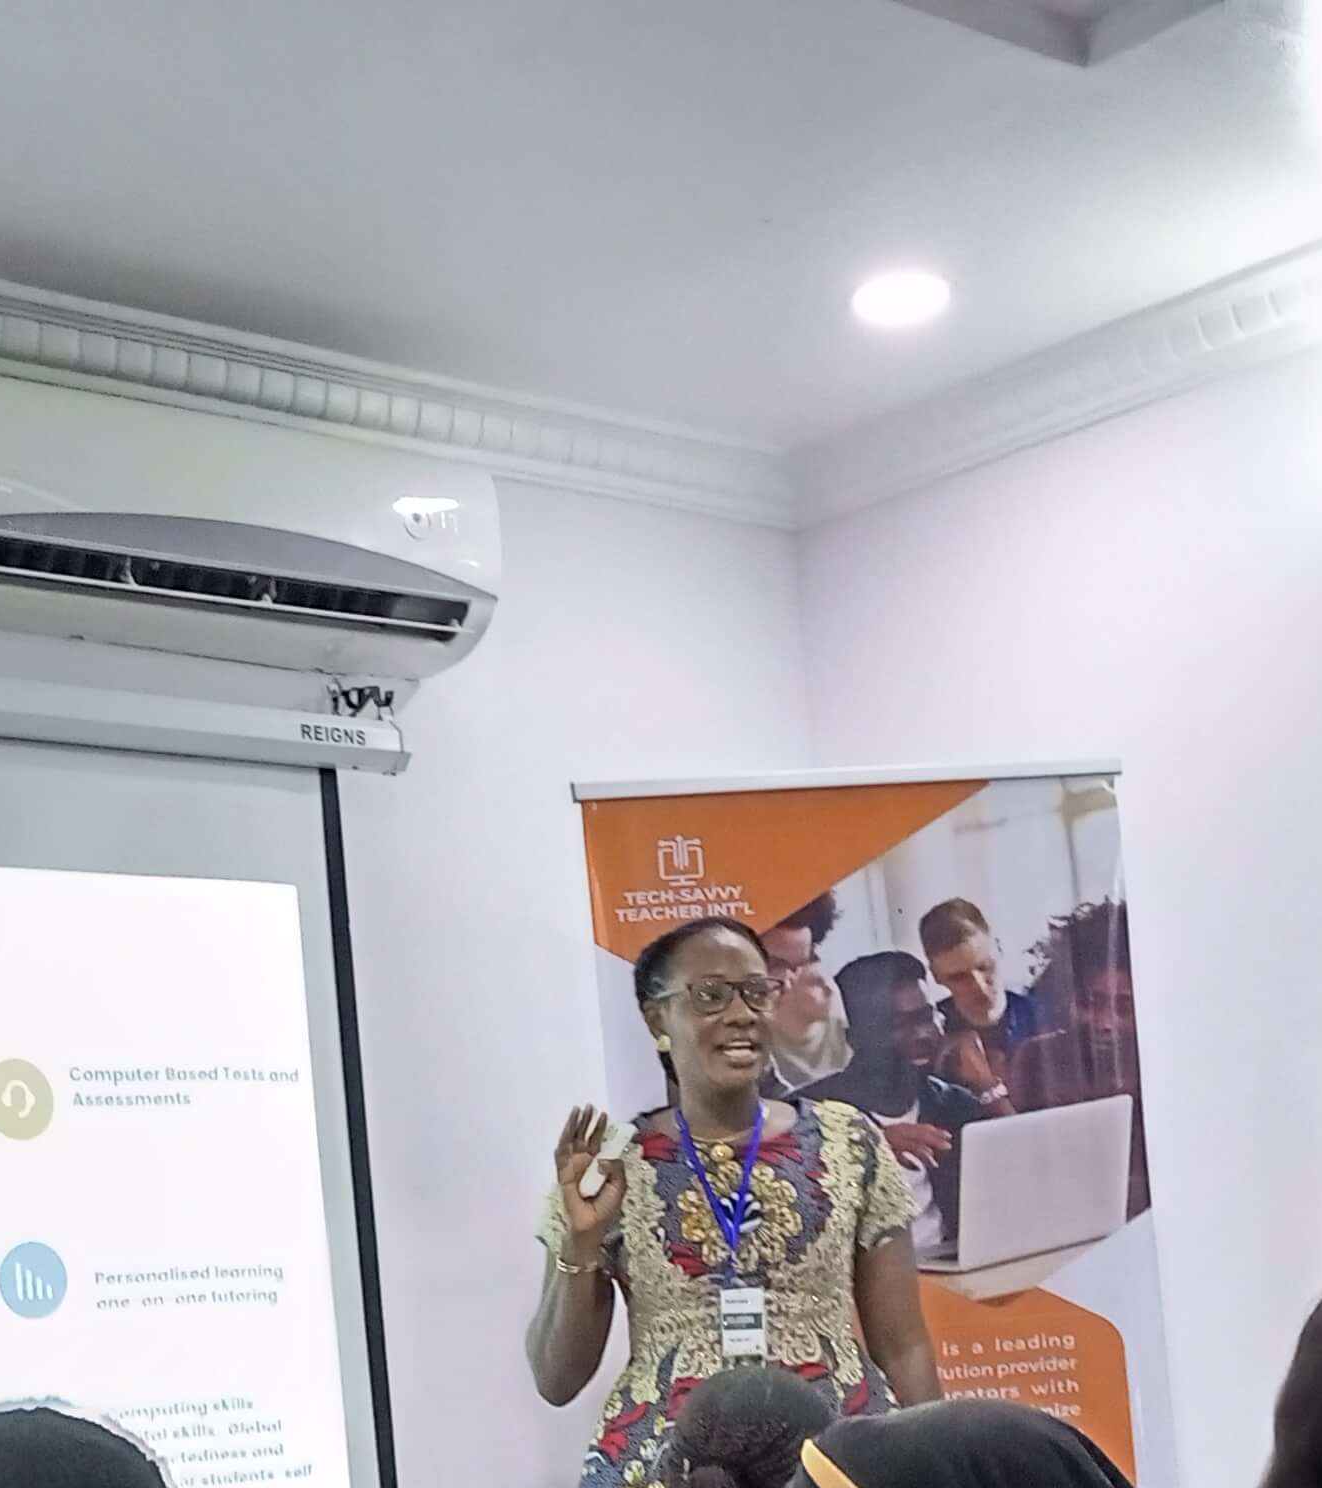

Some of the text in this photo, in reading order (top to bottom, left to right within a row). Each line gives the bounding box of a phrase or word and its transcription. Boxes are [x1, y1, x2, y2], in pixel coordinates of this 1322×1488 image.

[300, 723, 366, 746] REIGNS
[623, 885, 742, 906] TECH-SAVVY
[615, 903, 704, 923] TEACHER
[69, 1066, 300, 1086] Computer Based Tests and
[94, 1263, 284, 1286] Personalised learning
[211, 1287, 279, 1308] tutoring
[941, 1332, 1076, 1357] is a leading
[996, 1355, 1078, 1379] provider
[1030, 1378, 1080, 1396] with
